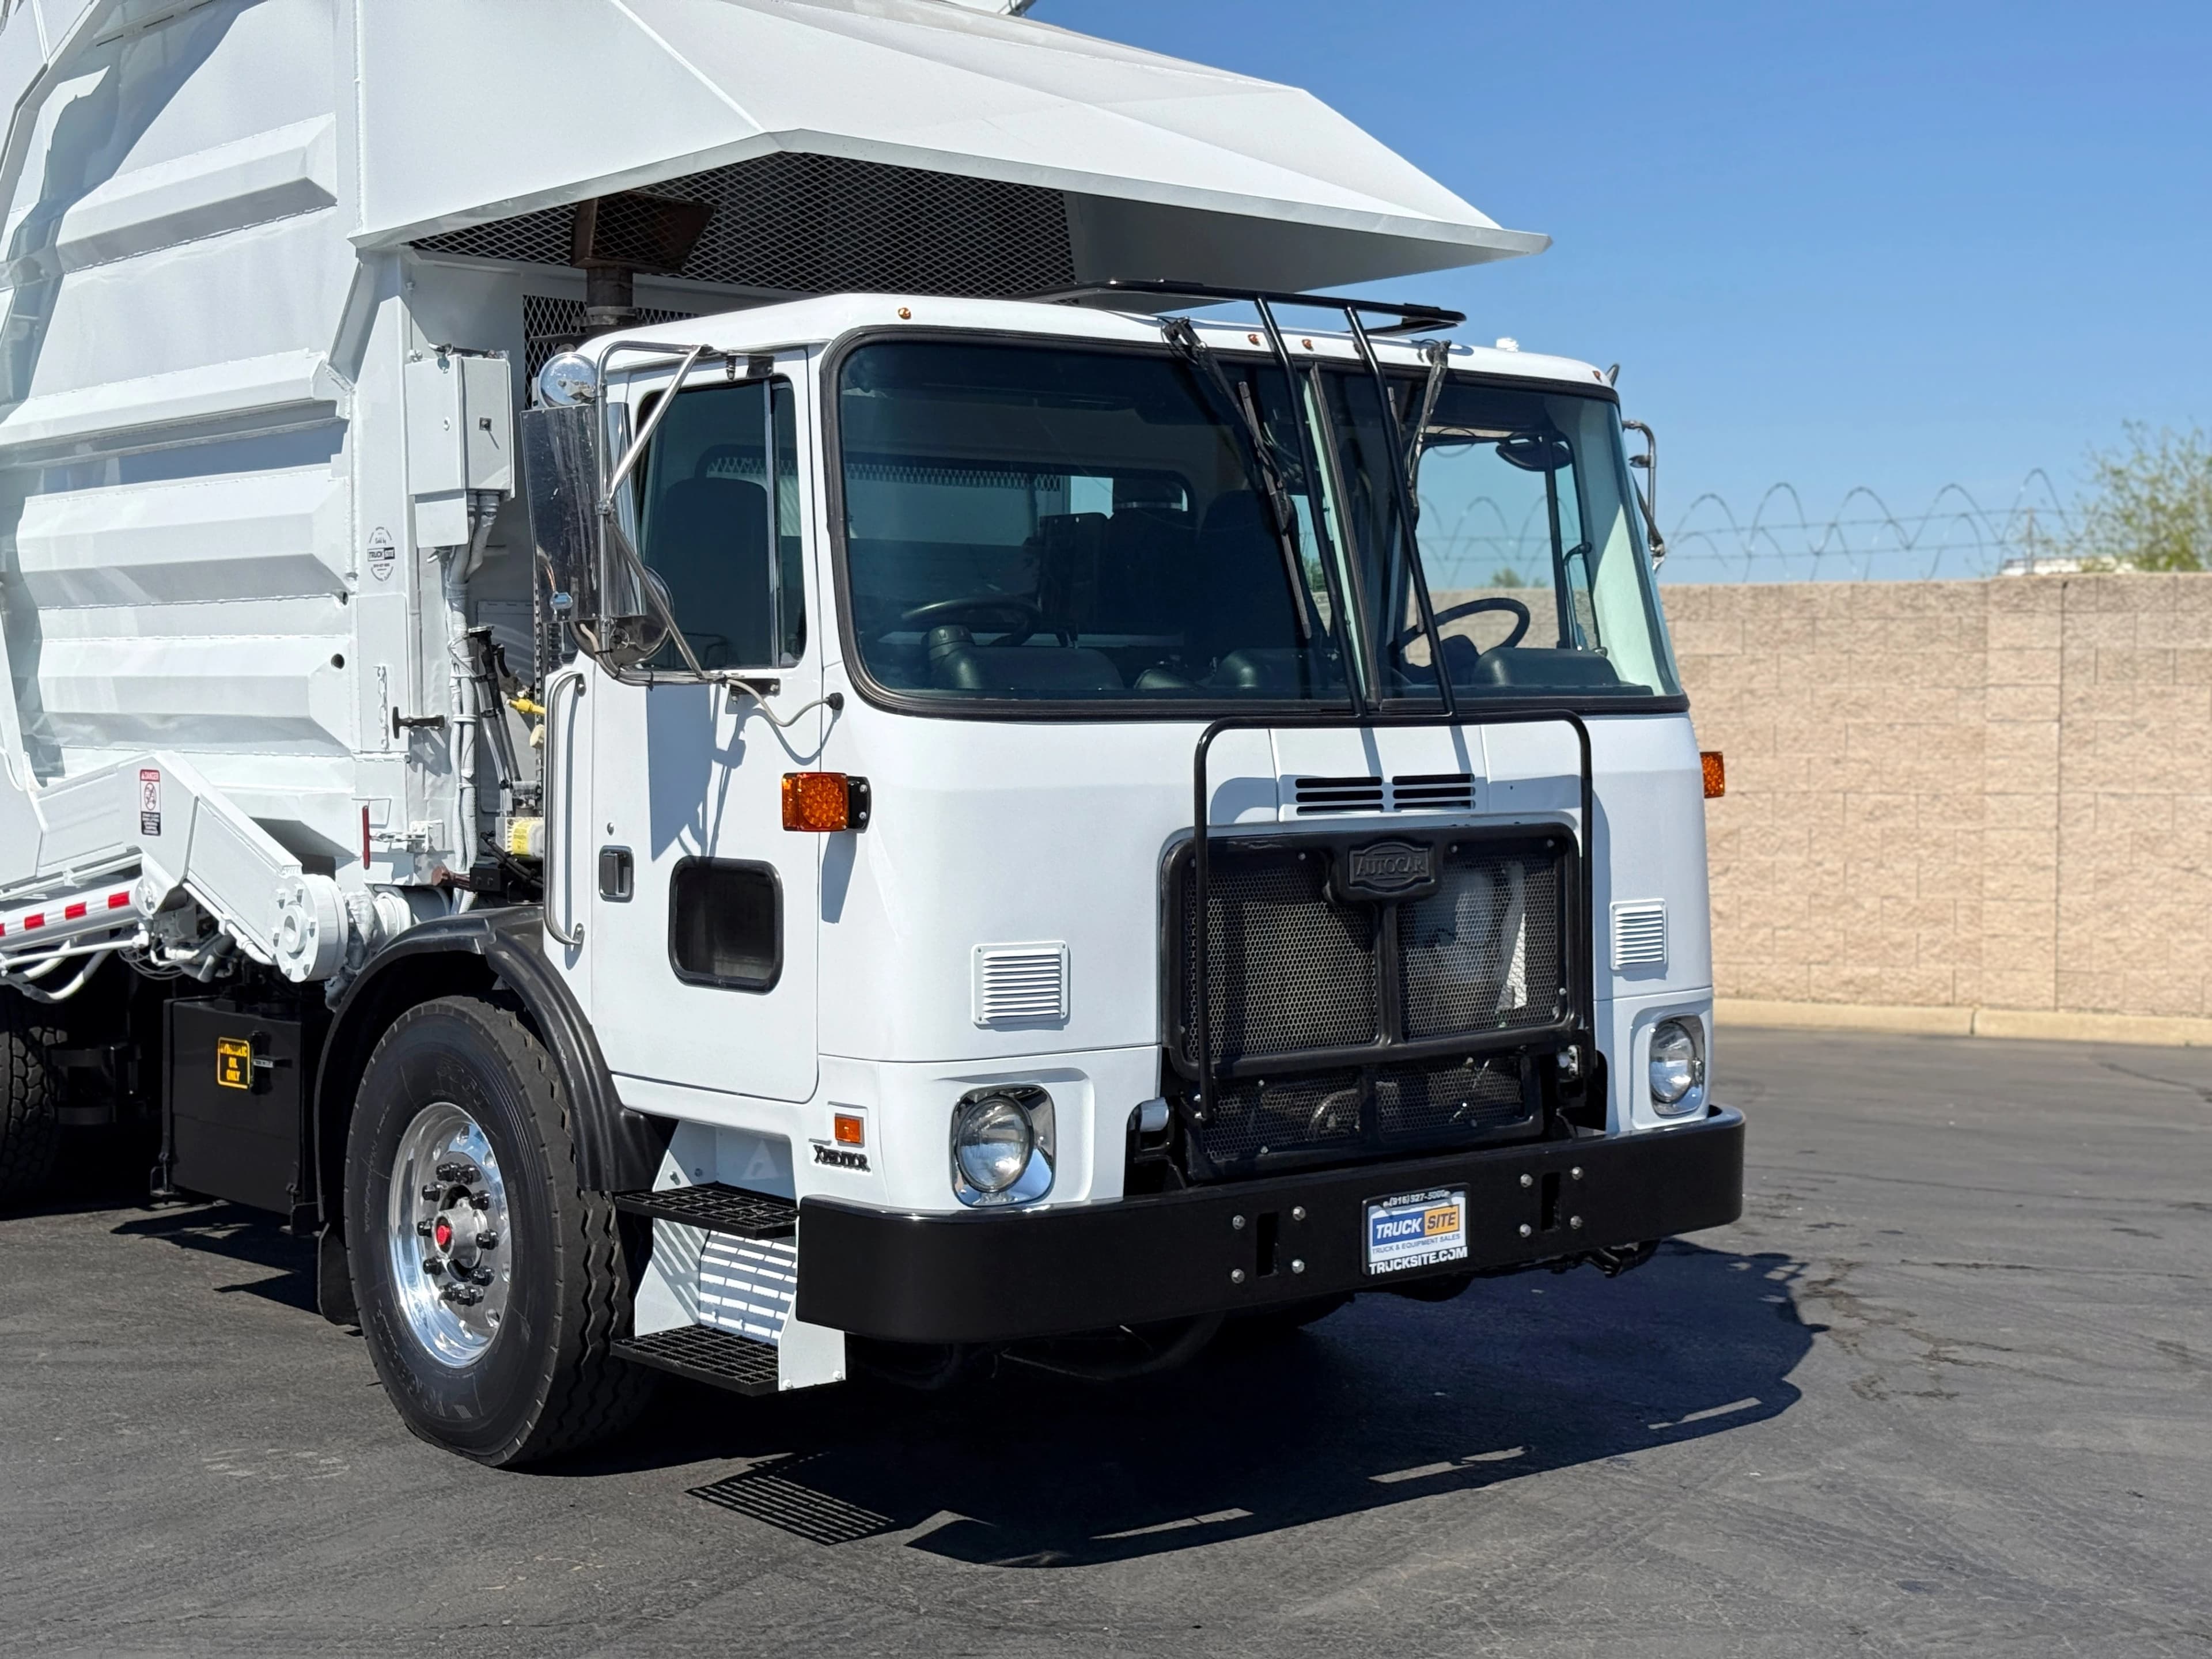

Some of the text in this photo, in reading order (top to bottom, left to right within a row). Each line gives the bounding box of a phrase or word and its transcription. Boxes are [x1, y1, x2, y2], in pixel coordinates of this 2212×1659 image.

[1356, 856, 1426, 876] AUTOCAR
[229, 1056, 238, 1069] OIL
[226, 1069, 241, 1082] ONLY
[1376, 1211, 1456, 1239] TRUCK SITE
[1372, 1245, 1395, 1254] TRUCK
[1402, 1237, 1438, 1249] EQUIPMENT
[1440, 1233, 1461, 1241] SALES
[1369, 1246, 1468, 1275] TRUCKSITE.COM
